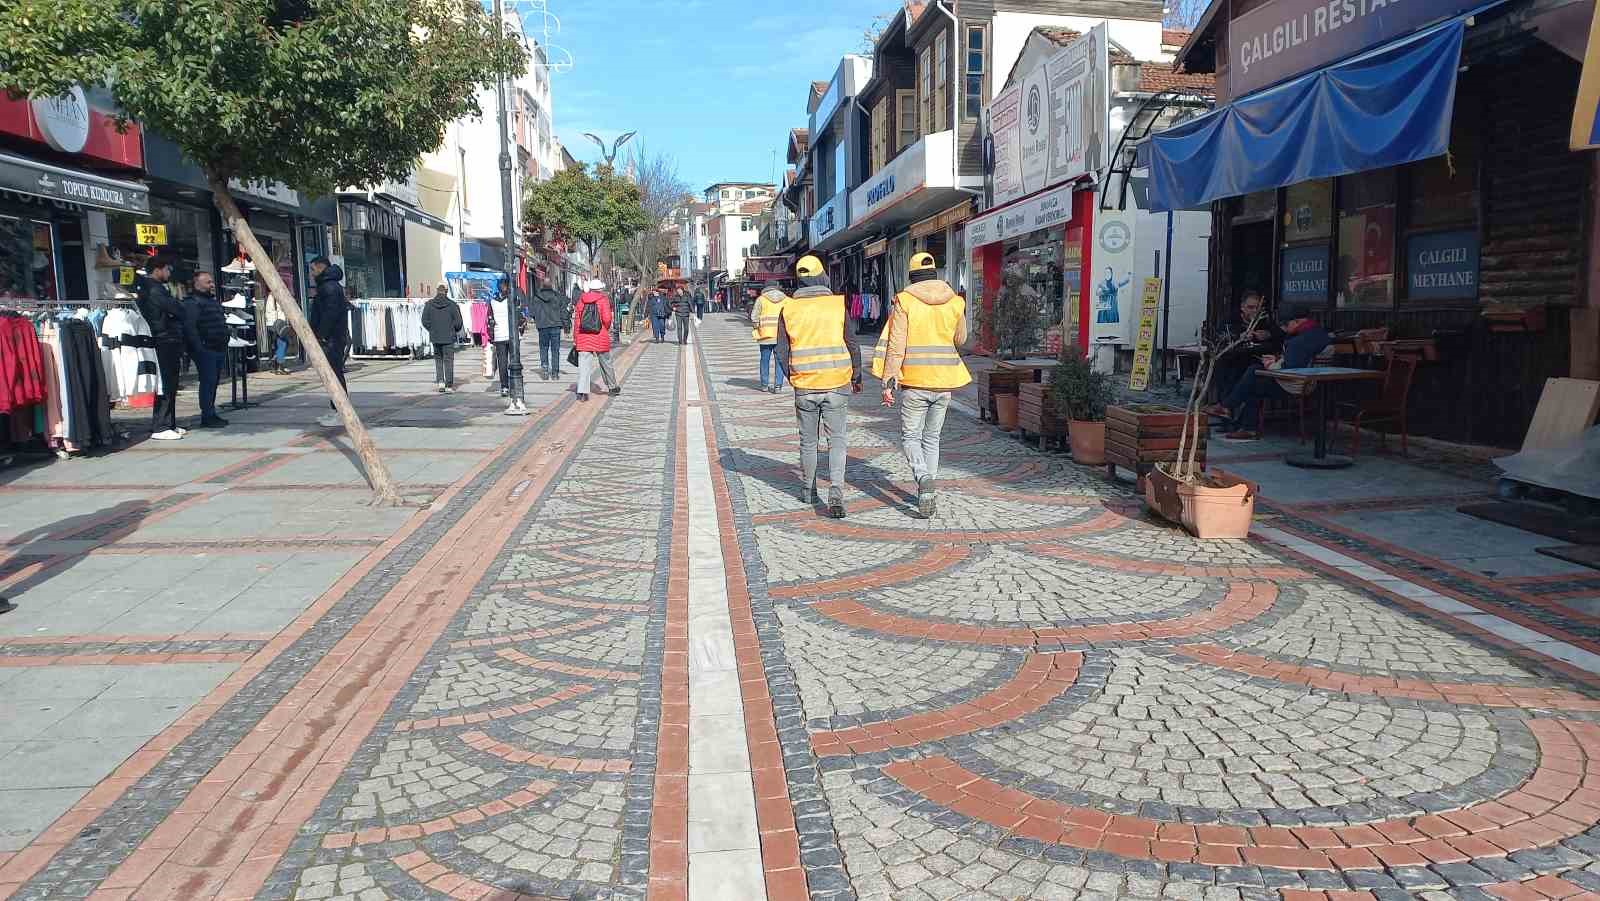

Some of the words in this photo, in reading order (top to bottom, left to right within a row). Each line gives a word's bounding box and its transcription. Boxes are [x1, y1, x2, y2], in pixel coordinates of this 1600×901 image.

[1241, 14, 1308, 73] ÇALGILI
[1314, 0, 1400, 37] REST
[61, 179, 89, 198] TOPUK
[90, 185, 125, 205] KUNDURA
[141, 225, 159, 235] 370
[143, 235, 156, 244] 22
[1419, 247, 1467, 267] ÇALGILI
[1289, 258, 1324, 275] ÇALGILI
[1284, 279, 1328, 292] MEYHANE
[1412, 270, 1474, 289] MEYHANE
